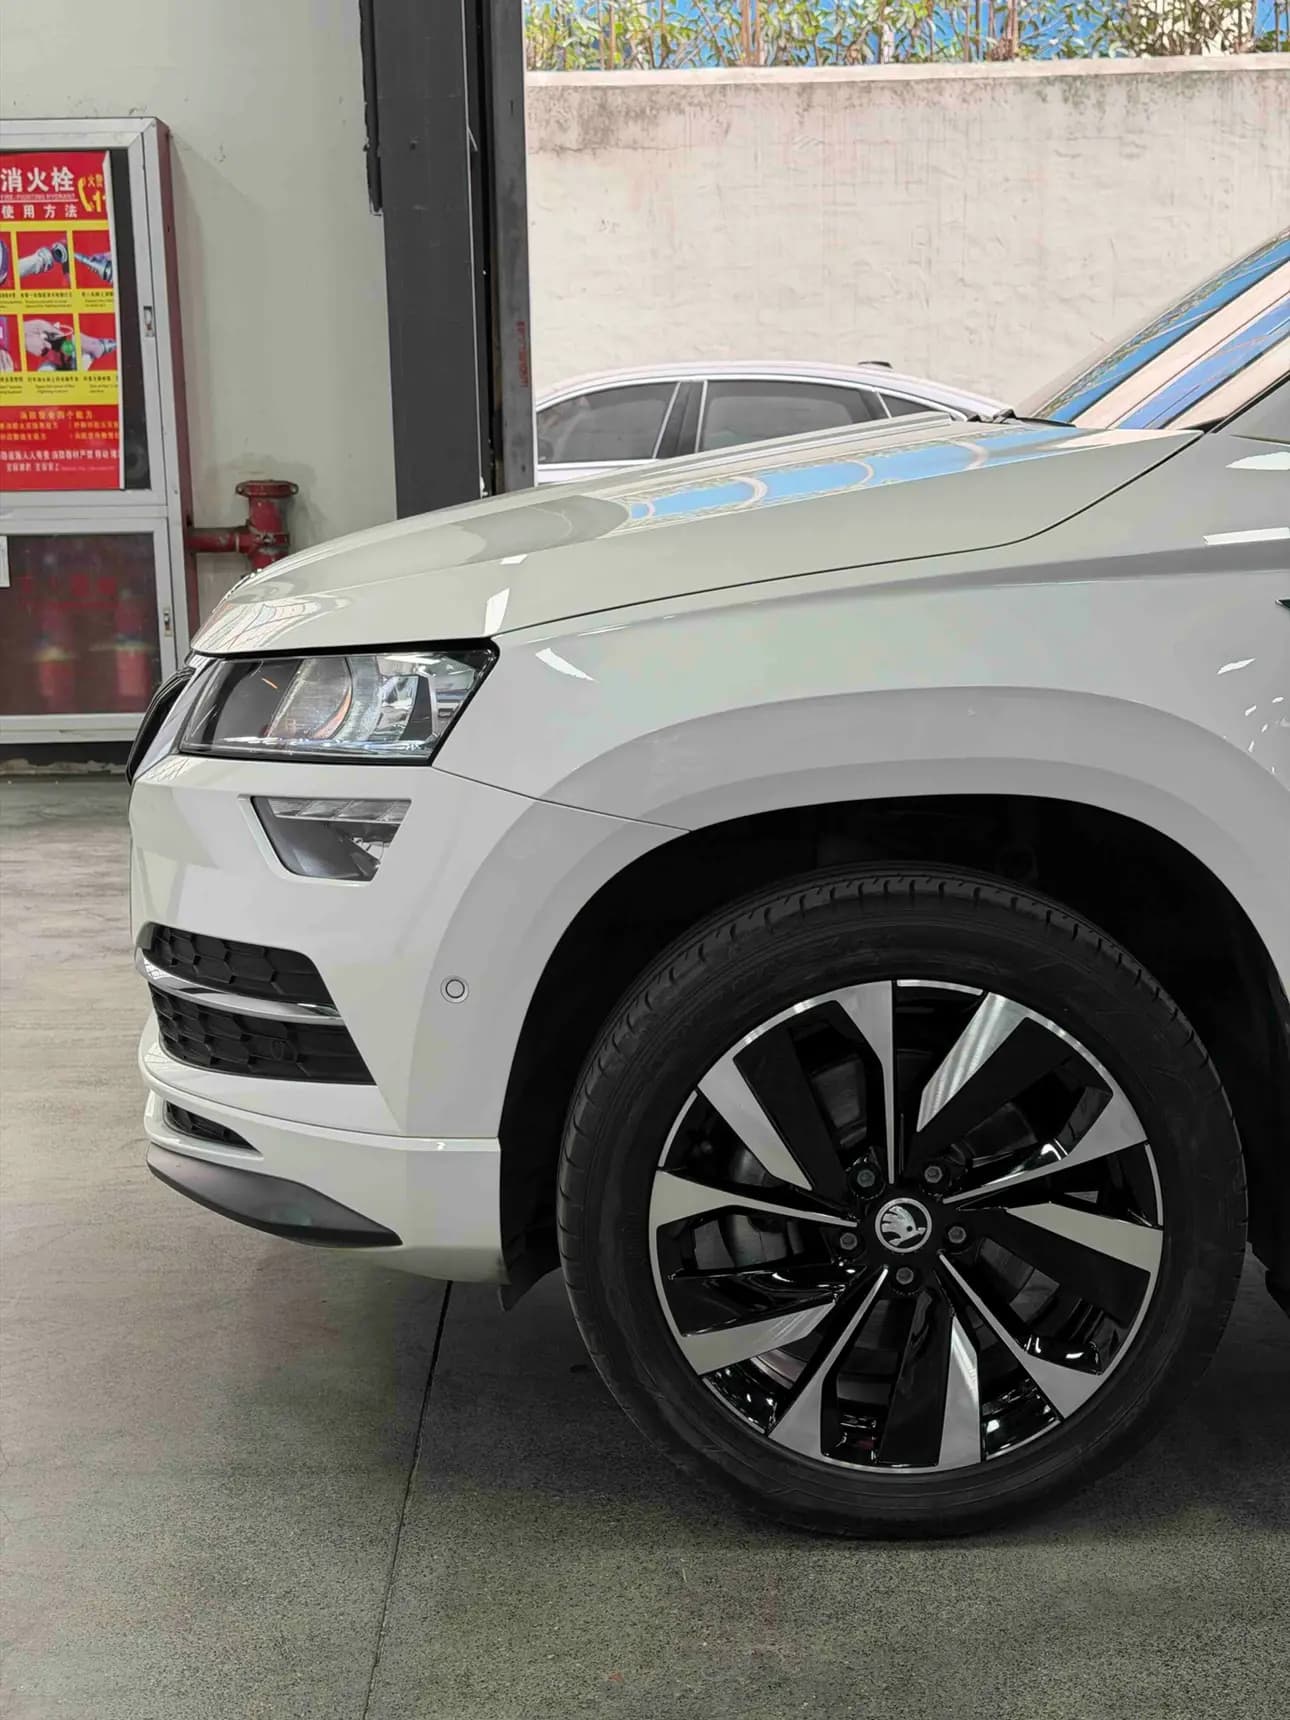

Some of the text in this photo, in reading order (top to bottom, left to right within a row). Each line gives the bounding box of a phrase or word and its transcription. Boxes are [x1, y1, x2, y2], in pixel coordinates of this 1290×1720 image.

[1, 166, 75, 192] 消火栓
[2, 204, 78, 219] 使用方法
